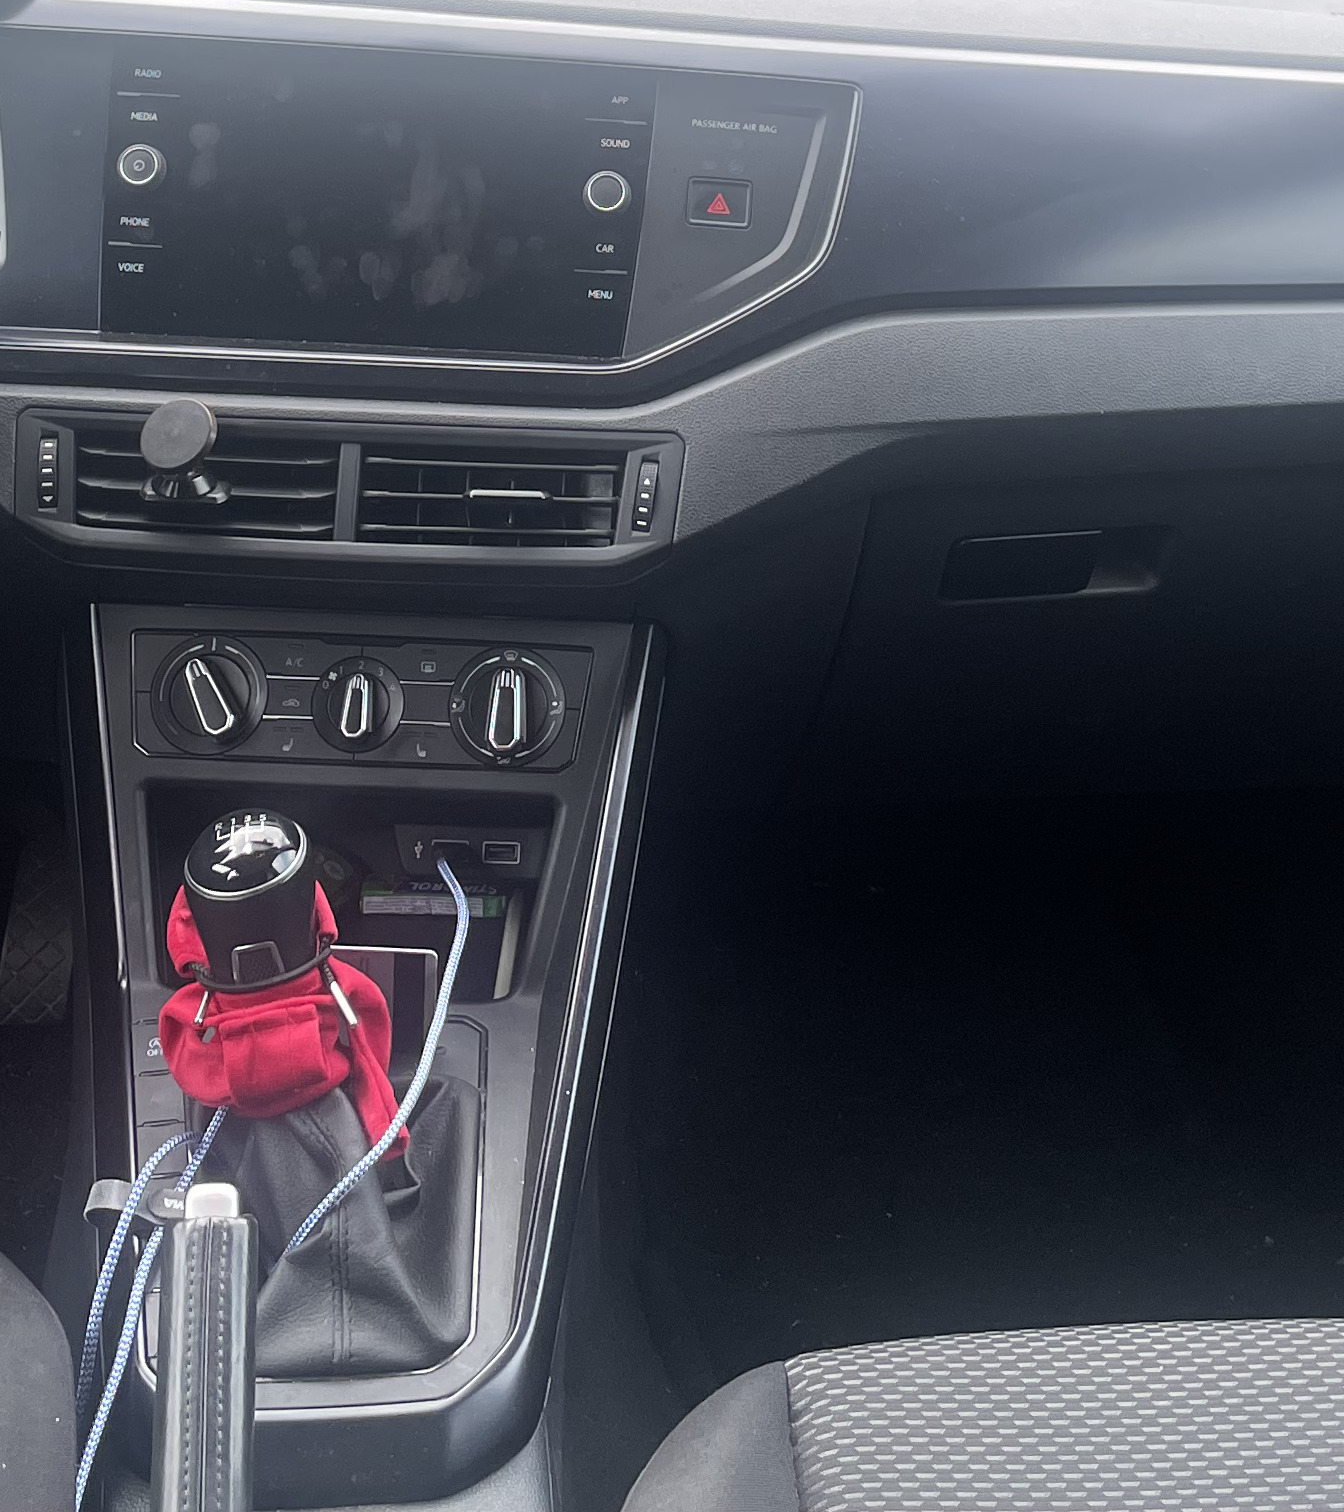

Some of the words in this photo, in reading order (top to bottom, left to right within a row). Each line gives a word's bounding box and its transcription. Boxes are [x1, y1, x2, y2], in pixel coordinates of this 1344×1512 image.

[134, 68, 162, 78] RADIO
[611, 96, 629, 105] APP
[130, 111, 158, 122] MEDIA
[691, 118, 740, 130] PASSENGER
[742, 123, 757, 132] AIR
[758, 124, 778, 134] BAG
[600, 138, 630, 148] SOUND
[120, 216, 150, 226] PHONE
[595, 244, 615, 253] CAR
[117, 262, 145, 273] VOICE
[587, 289, 613, 300] MENU
[285, 657, 303, 668] A/C
[358, 660, 365, 670] 2
[338, 666, 343, 675] 1
[377, 667, 384, 677] 3
[230, 817, 236, 825] 1
[259, 813, 267, 822] 5
